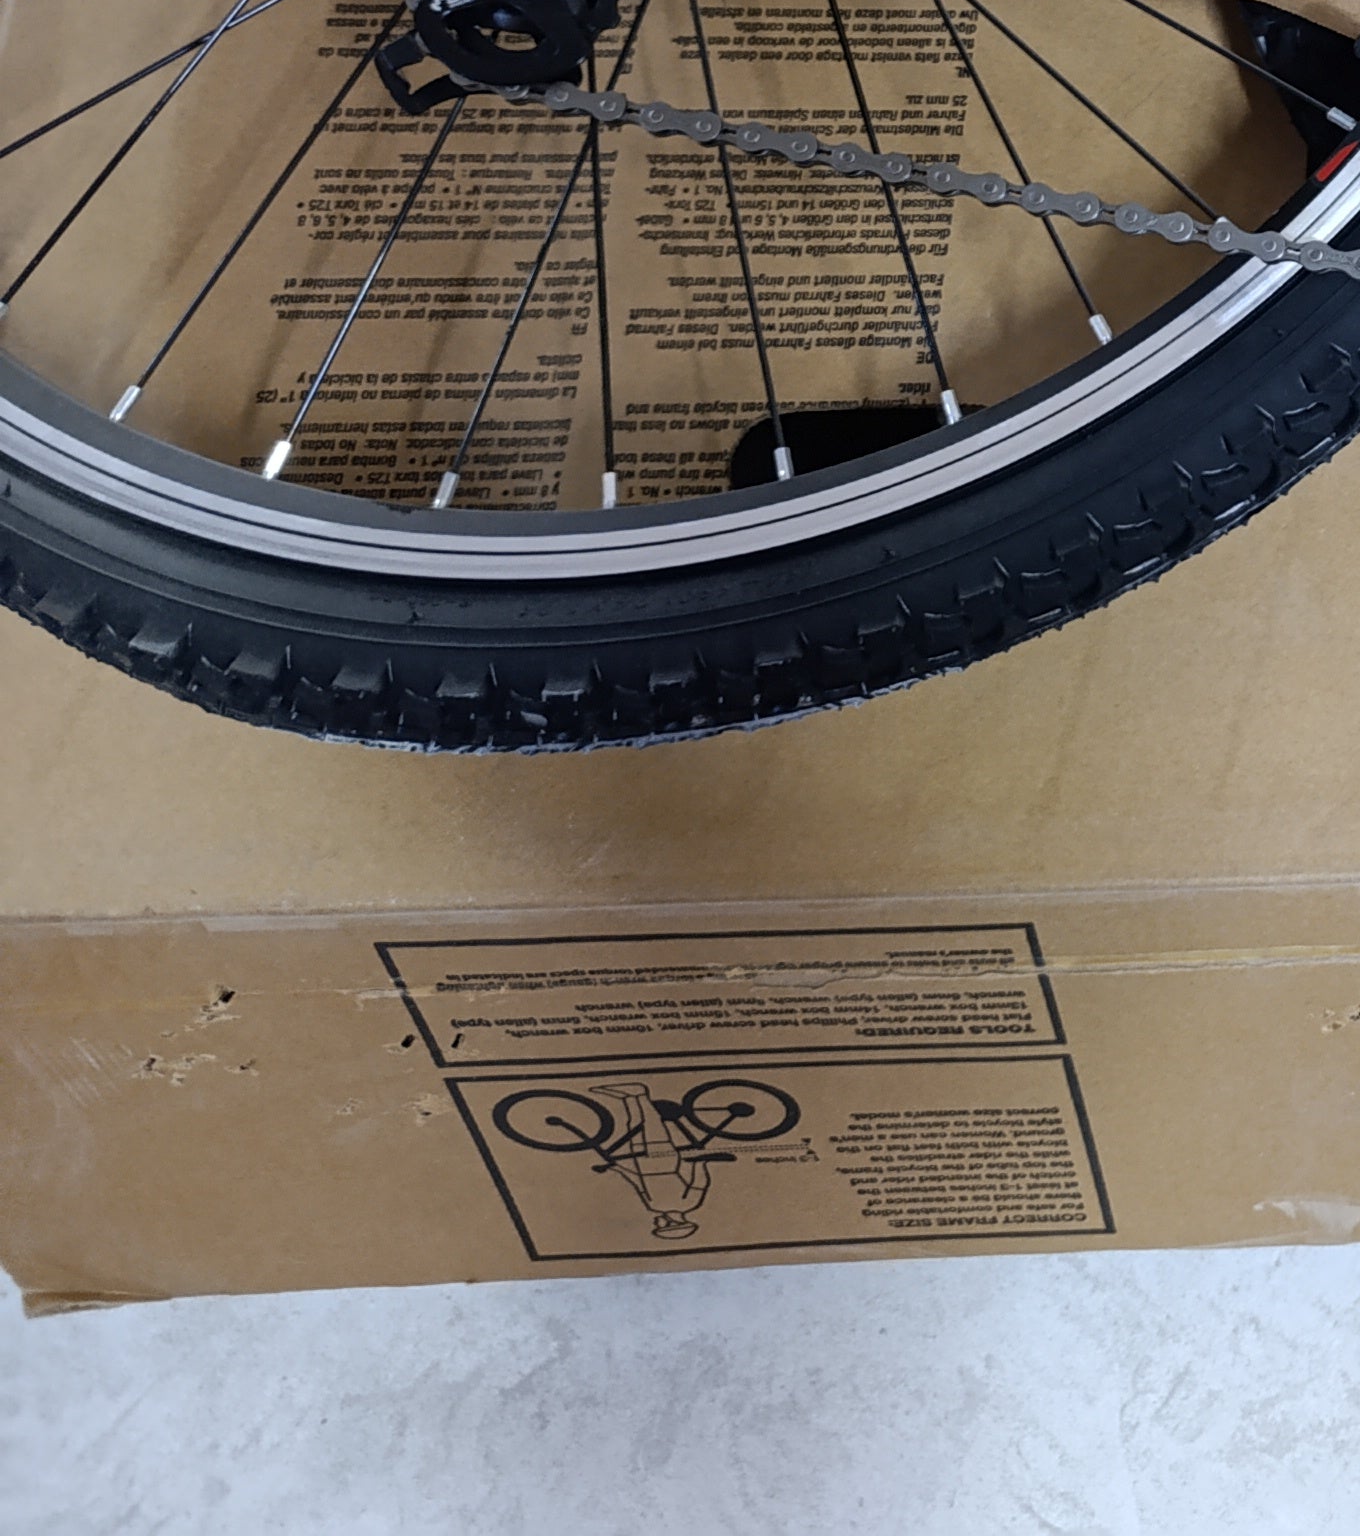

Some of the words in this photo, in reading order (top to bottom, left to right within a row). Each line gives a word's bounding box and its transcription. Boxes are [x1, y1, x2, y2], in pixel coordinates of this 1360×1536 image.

[786, 51, 814, 62] door
[916, 52, 940, 64] fiets
[925, 94, 949, 104] mm
[952, 94, 968, 106] 25
[722, 110, 744, 120] von
[748, 107, 810, 121] Spielraum
[812, 110, 846, 120] einen
[901, 109, 922, 121] und
[926, 109, 966, 121] Fahrer
[788, 276, 811, 288] und
[814, 274, 866, 288] montiert
[757, 291, 790, 302] muss
[794, 291, 842, 304] Fahrrad
[844, 290, 886, 302] Dieses
[778, 306, 830, 318] montiert
[834, 304, 888, 318] komplett
[892, 305, 912, 316] nur
[625, 324, 674, 336] Fahrrad
[678, 323, 719, 334] Dieses
[780, 320, 859, 334] durchgeführt
[656, 339, 694, 350] einem
[698, 338, 718, 351] bei
[722, 338, 754, 349] muss
[816, 337, 855, 350] dieses
[859, 334, 912, 349] Montage
[360, 388, 378, 400] no
[854, 1026, 964, 1036] REQUIRED:
[968, 1024, 1035, 1034] TOOLS
[936, 1215, 998, 1226] FRAME
[1003, 1213, 1087, 1225] CORRECT
